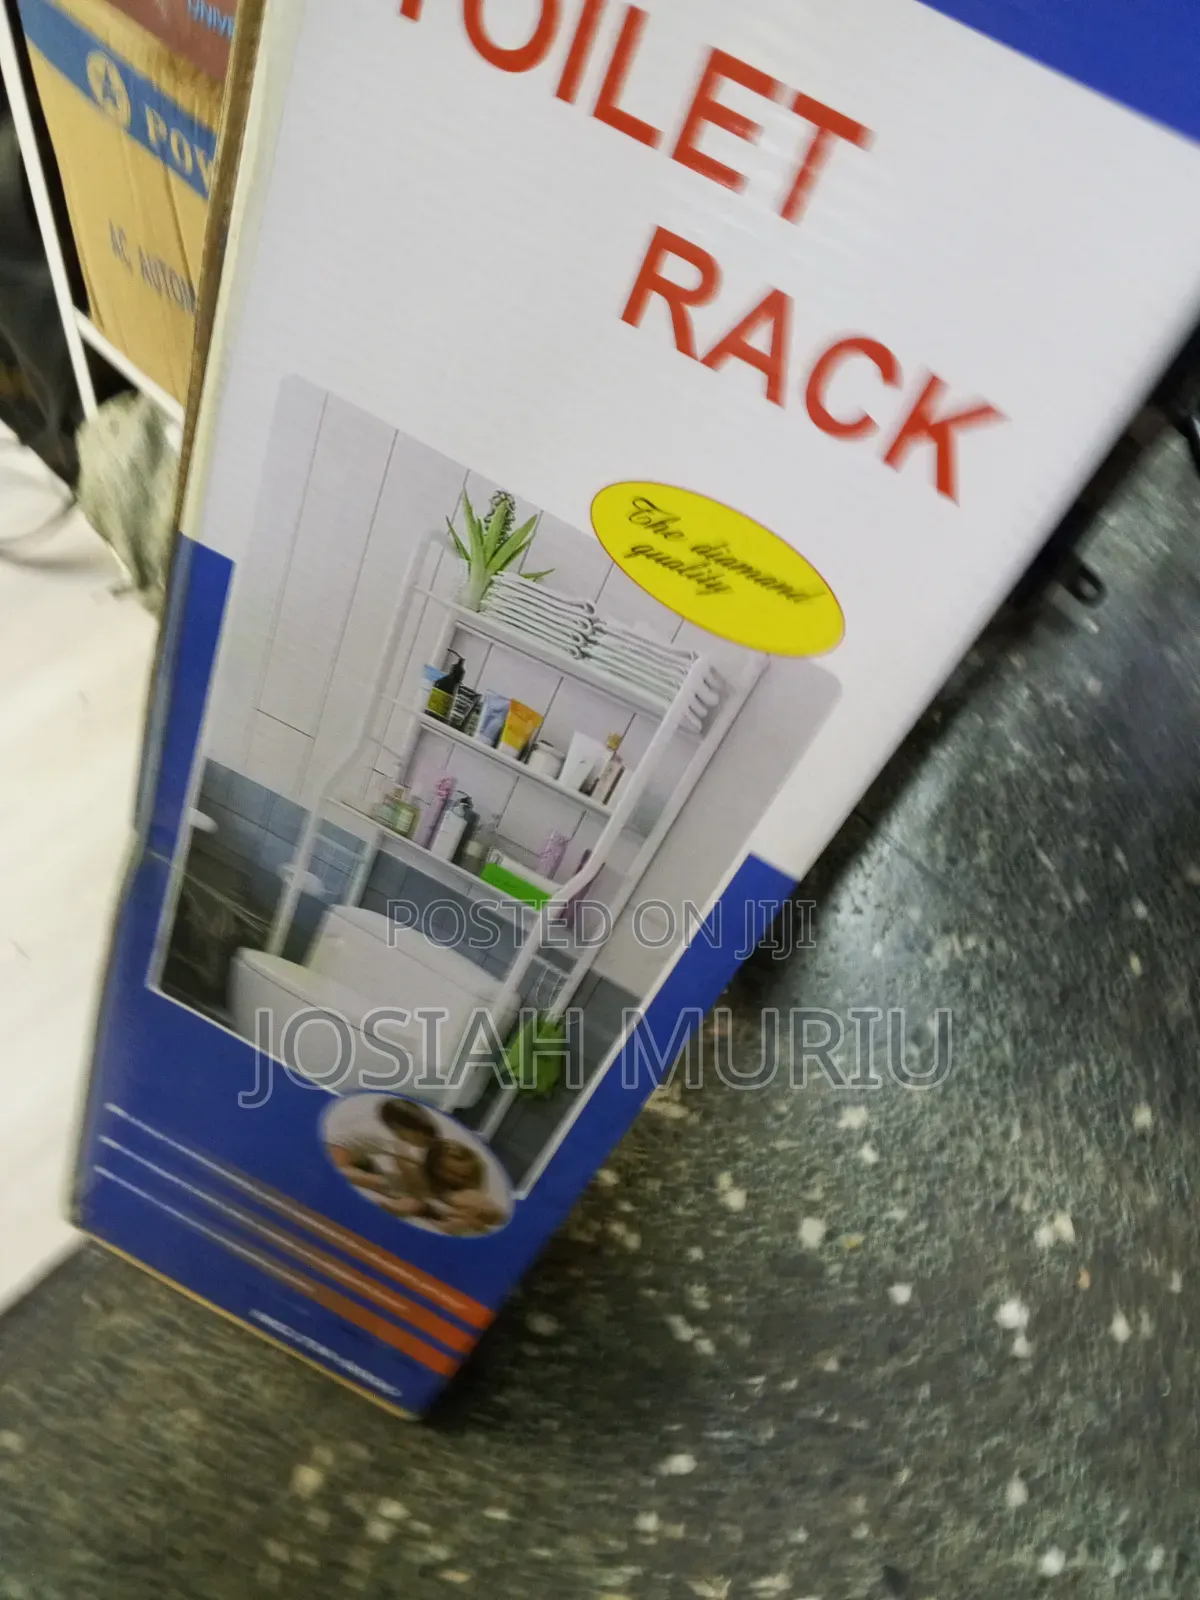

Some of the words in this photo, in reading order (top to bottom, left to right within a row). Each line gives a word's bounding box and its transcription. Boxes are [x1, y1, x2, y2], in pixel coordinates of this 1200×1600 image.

[398, 0, 877, 226] OILET
[620, 222, 1010, 507] RACK
[624, 544, 734, 596] quality
[627, 495, 686, 542] The
